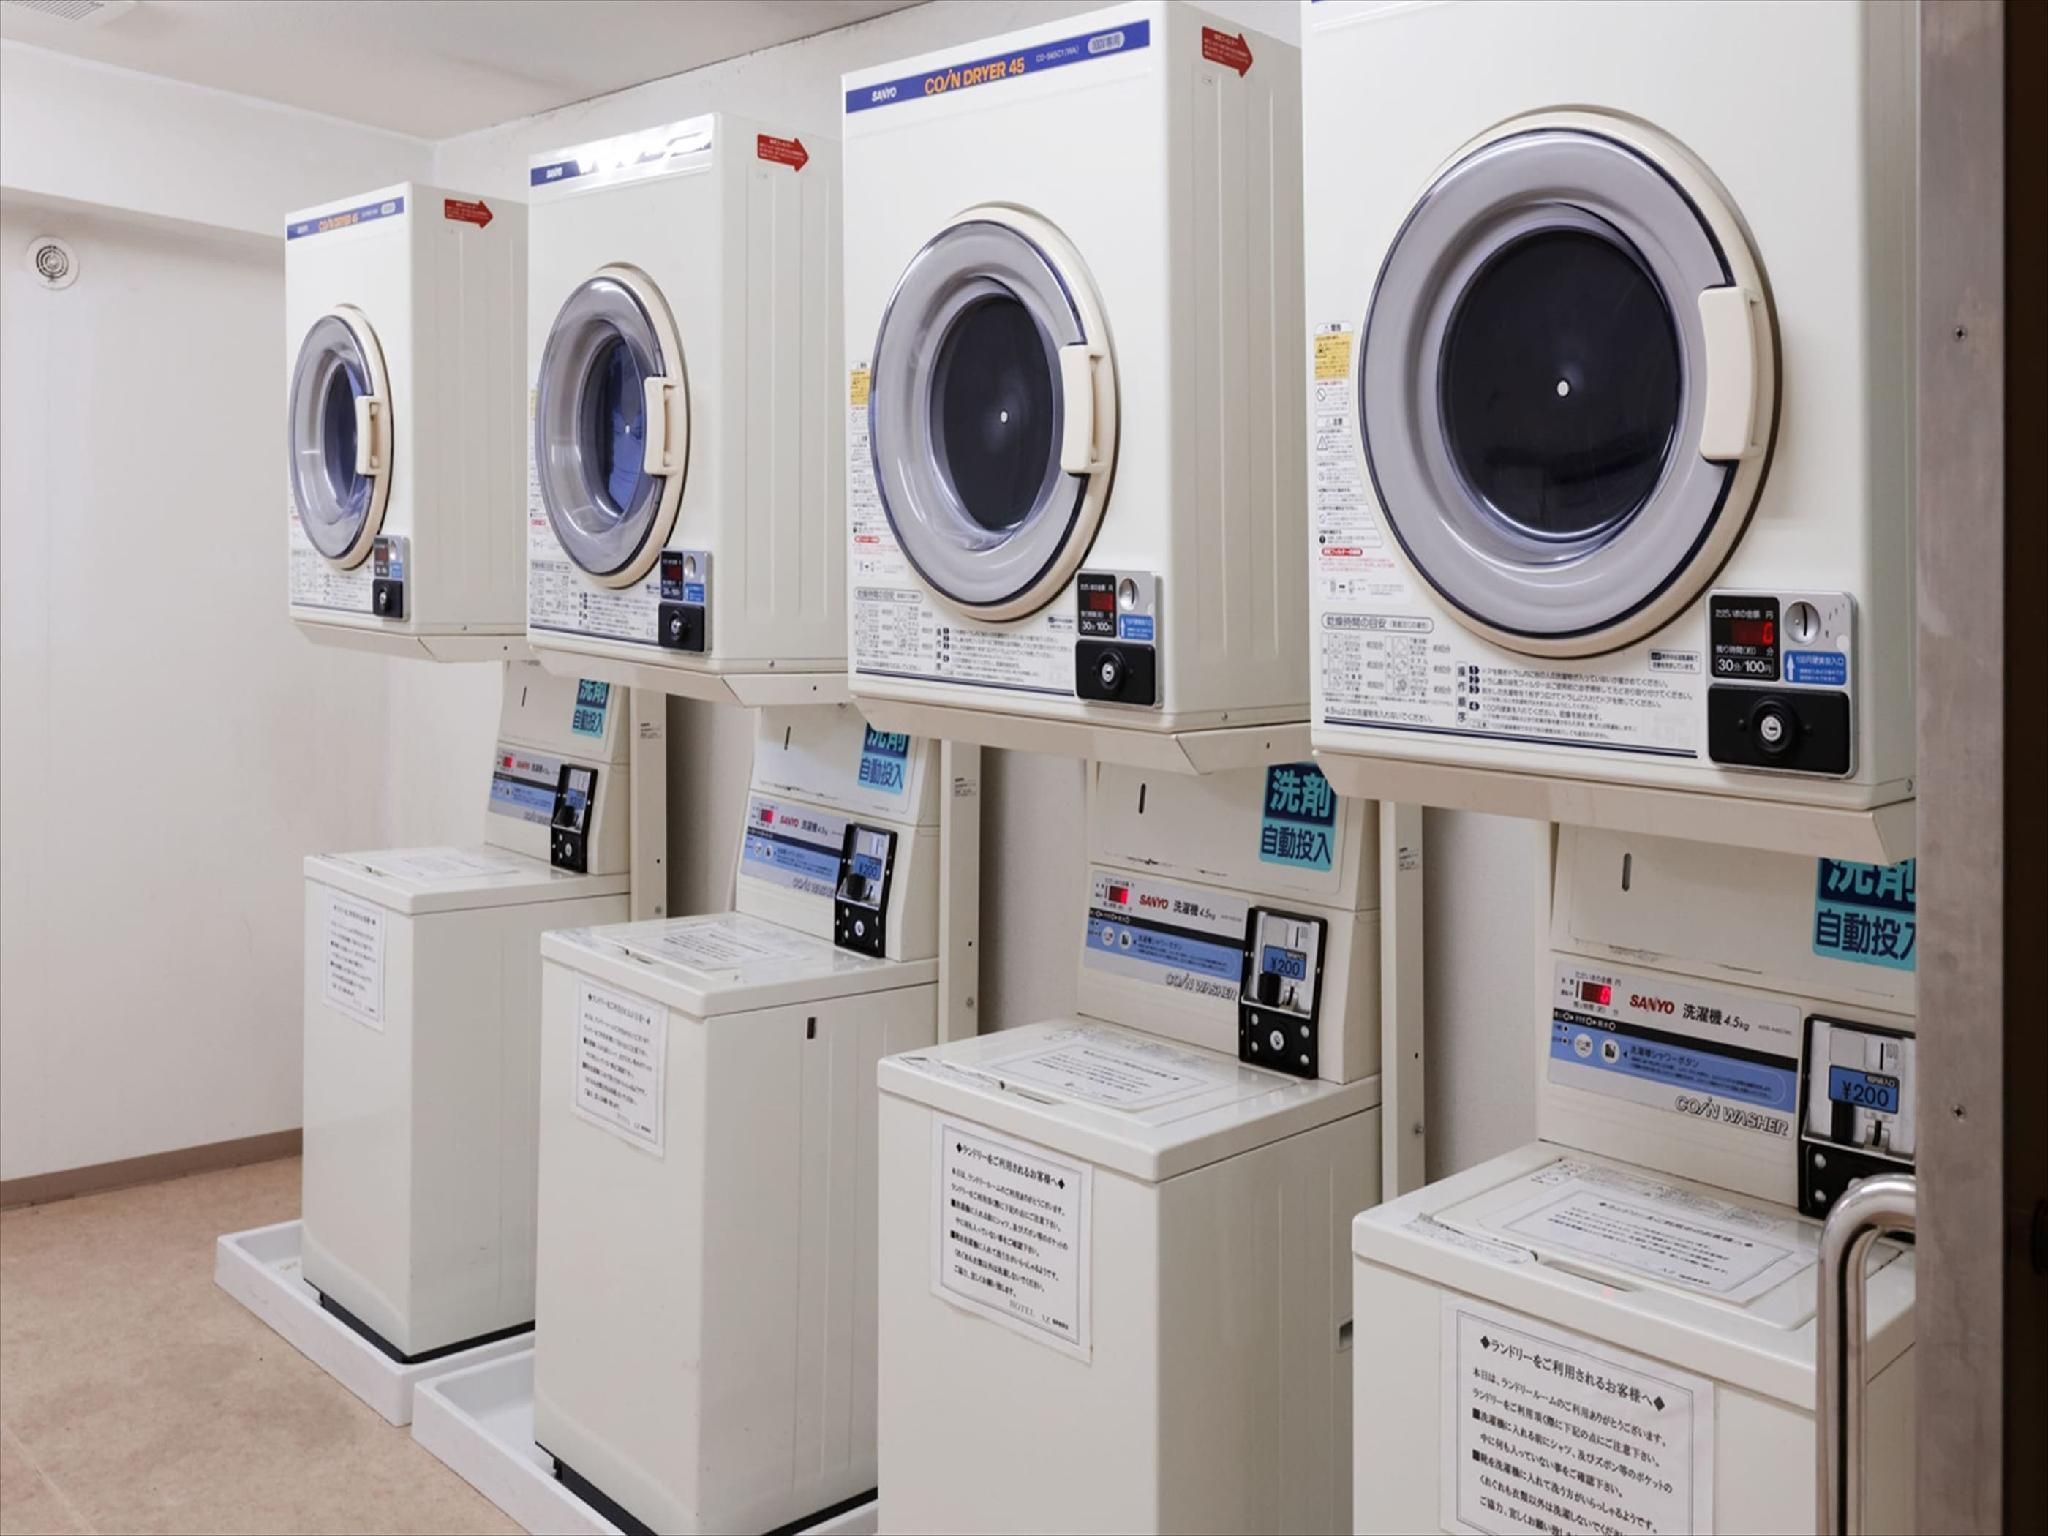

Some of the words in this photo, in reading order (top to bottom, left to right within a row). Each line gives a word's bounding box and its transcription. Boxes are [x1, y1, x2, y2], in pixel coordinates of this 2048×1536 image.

[963, 62, 1006, 87] DRYER
[1008, 57, 1025, 75] 45
[871, 85, 897, 103] SANYO
[859, 757, 904, 790] 自動投入
[1269, 768, 1331, 817] 洗剤
[1261, 824, 1331, 864] 自動投入
[1139, 894, 1168, 910] SANYO
[1173, 900, 1198, 917] 洗濯機
[1270, 957, 1300, 977] ¥200
[1629, 994, 1675, 1014] SANYO
[1683, 1003, 1723, 1026] 洗濯機
[1723, 1013, 1750, 1031] 4.5kg
[1842, 1080, 1889, 1107] ¥200
[1721, 1106, 1788, 1137] WASHER
[1491, 1339, 1654, 1407] ランドリーをご利用されるお客様へ
